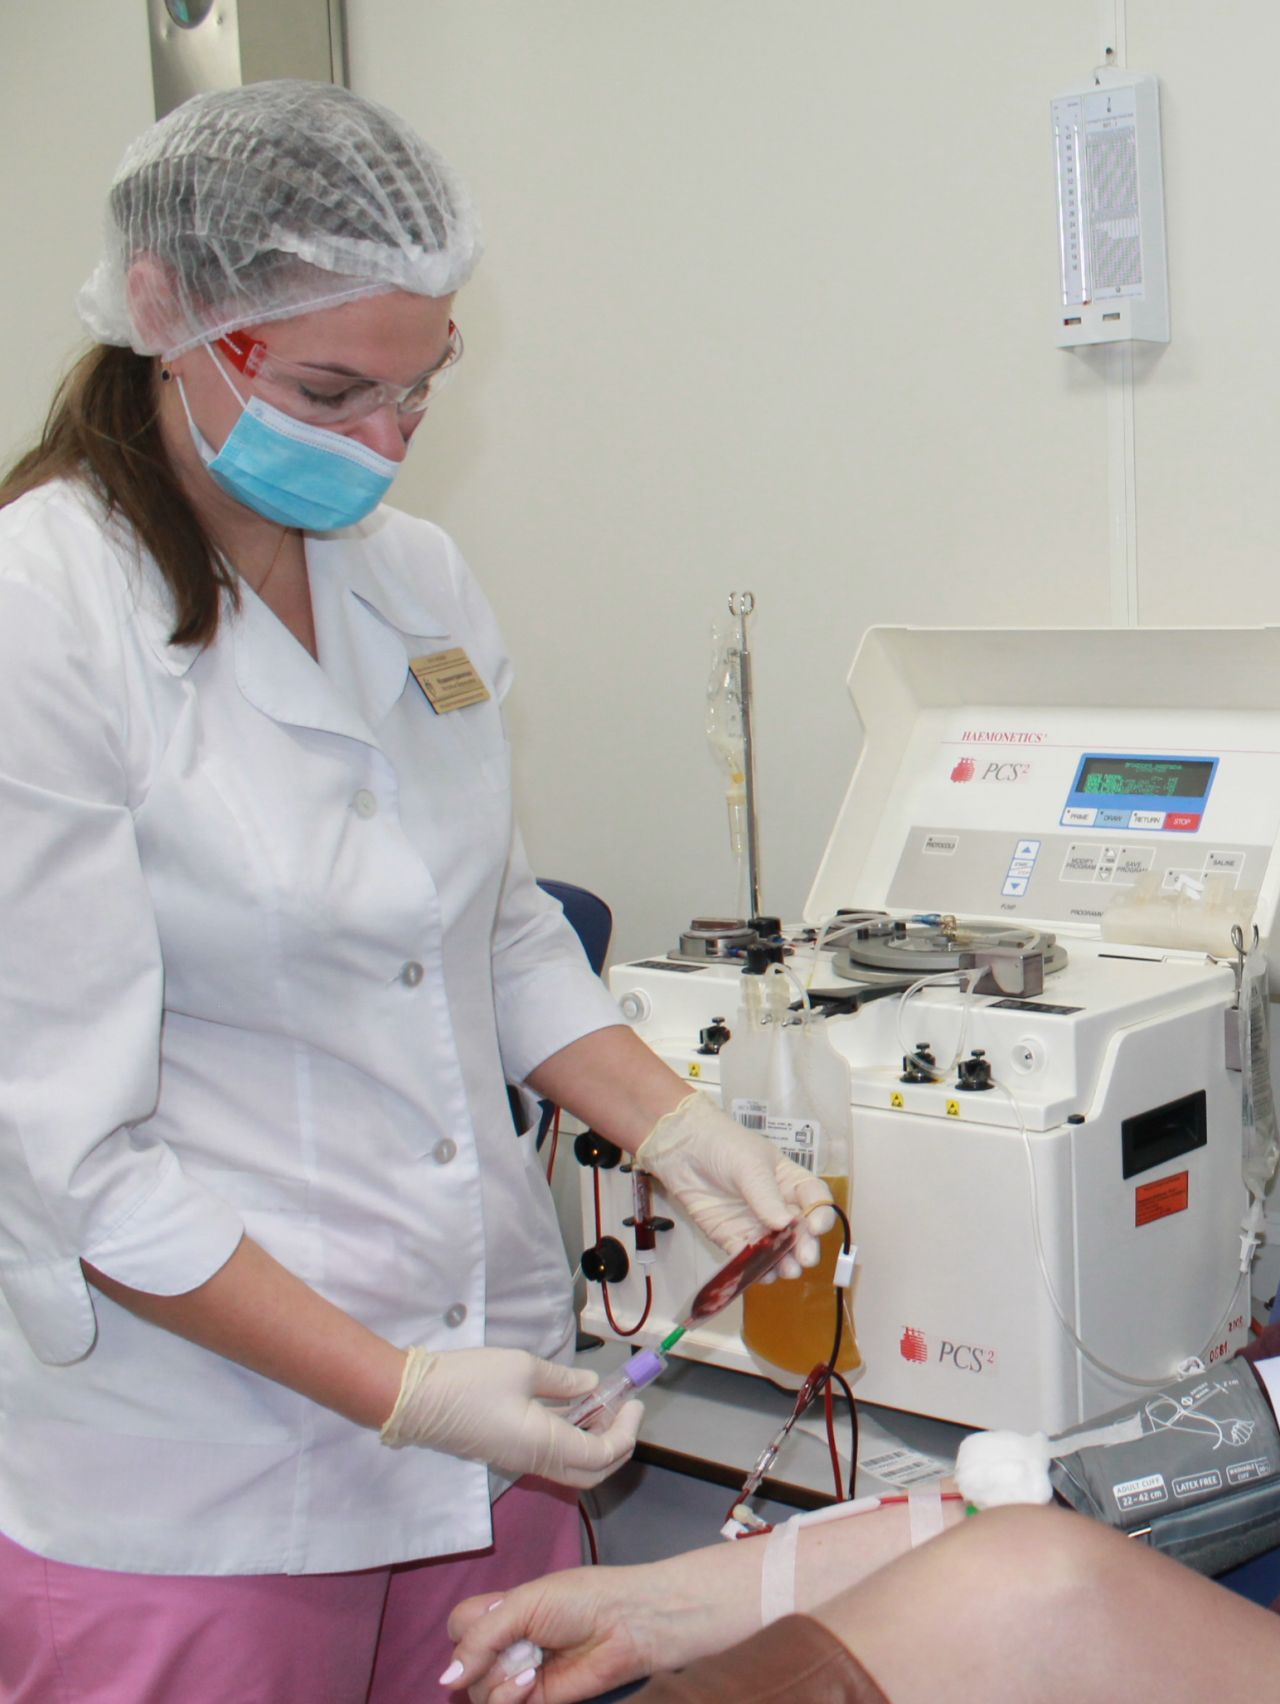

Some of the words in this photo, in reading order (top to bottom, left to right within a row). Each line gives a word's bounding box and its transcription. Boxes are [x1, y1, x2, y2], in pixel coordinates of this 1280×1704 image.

[961, 731, 1042, 743] HAEMONETICS
[1134, 815, 1160, 824] RETURN
[1173, 817, 1191, 826] STOP
[1116, 1482, 1140, 1494] ADULT
[1142, 1476, 1161, 1488] CUFF
[1175, 1480, 1199, 1493] LATEX
[1199, 1475, 1218, 1487] FREE
[1150, 1490, 1163, 1499] cm
